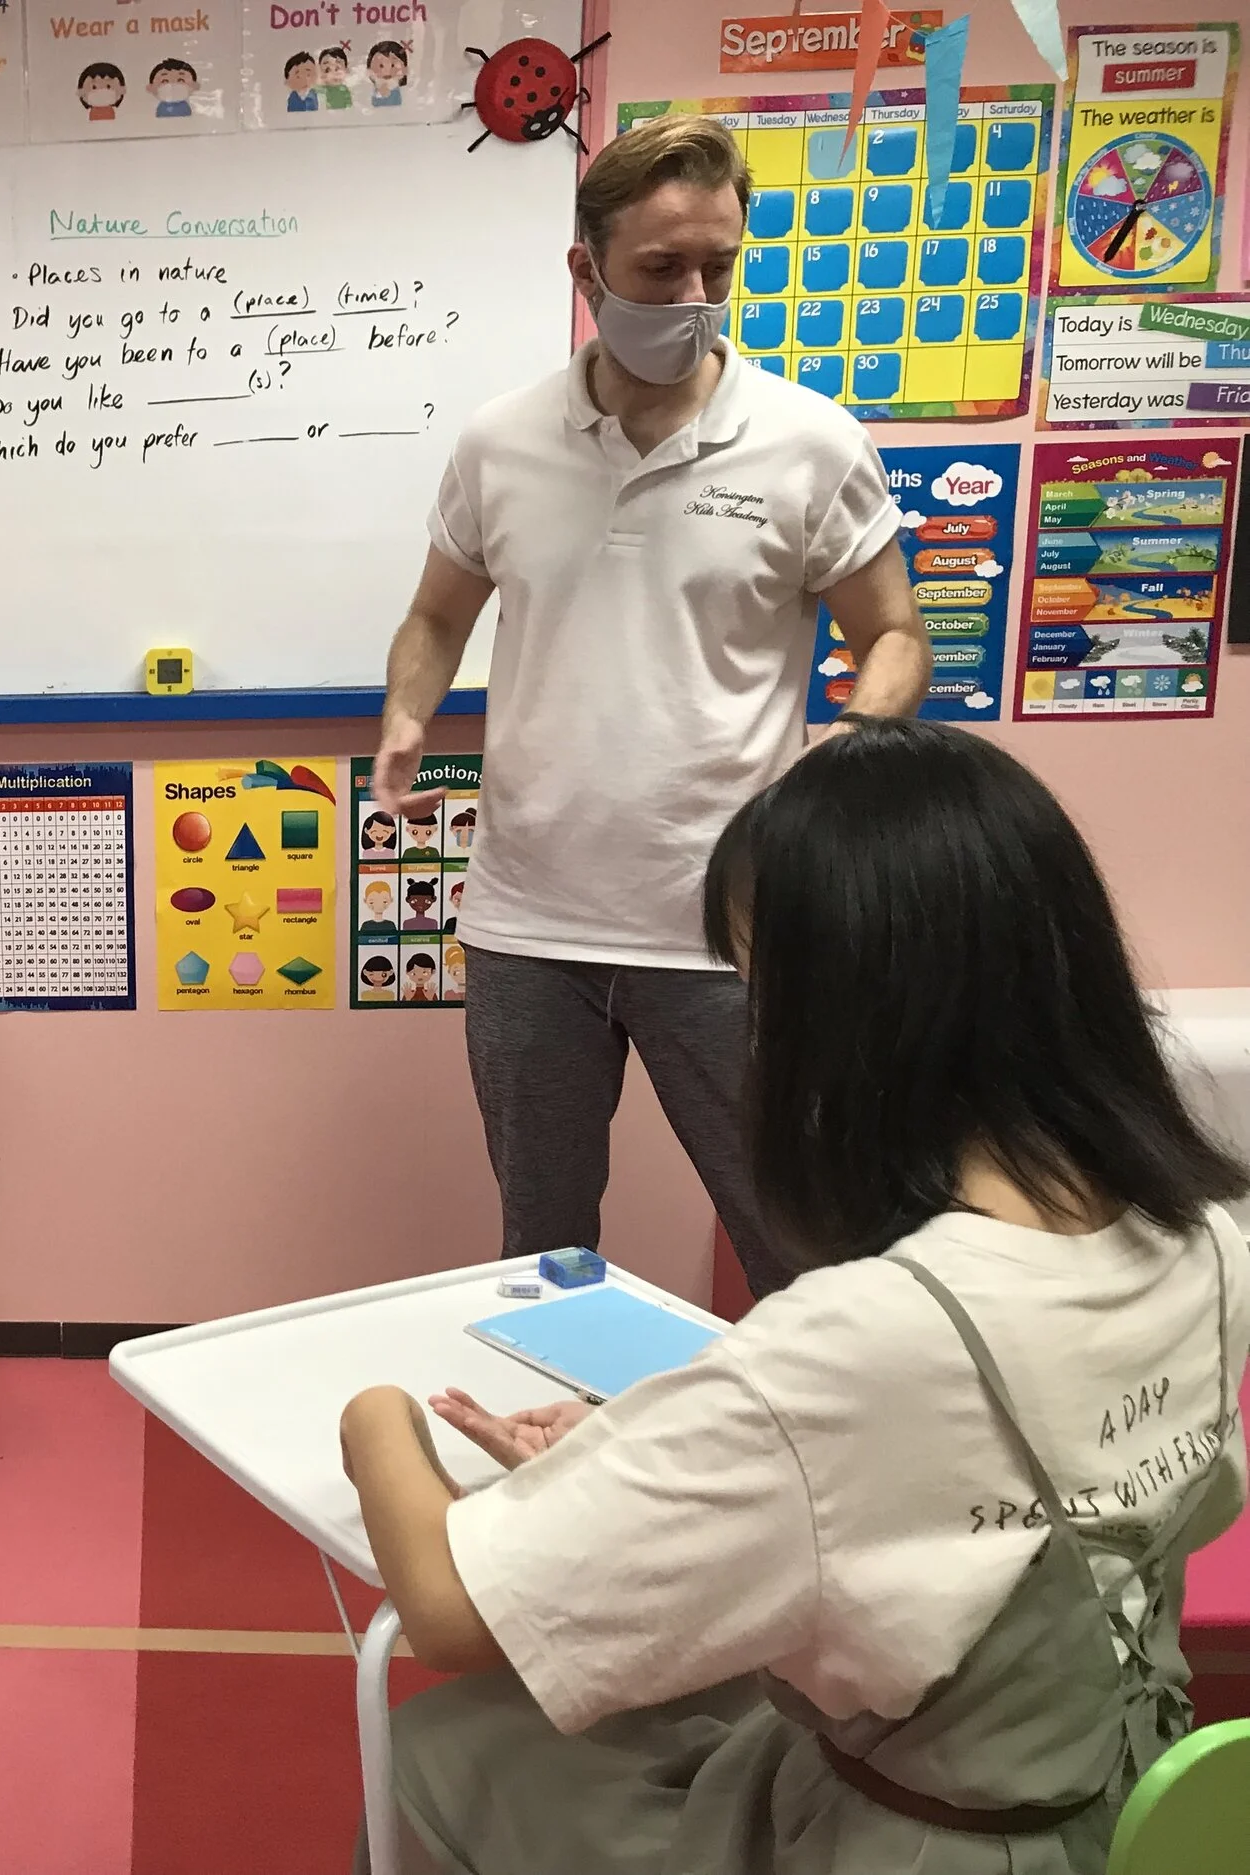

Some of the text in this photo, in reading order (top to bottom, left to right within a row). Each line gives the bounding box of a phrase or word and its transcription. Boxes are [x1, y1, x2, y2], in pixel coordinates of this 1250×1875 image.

[270, 1, 427, 29] Don't touch
[50, 10, 209, 39] Wear a mask
[1093, 38, 1217, 56] The season is
[1115, 66, 1186, 85] summer
[872, 110, 920, 120] Thursday
[990, 104, 1037, 116] Saturday
[757, 115, 796, 125] Tuesday
[1081, 107, 1215, 126] The weather is
[872, 130, 884, 144] 2
[50, 208, 298, 236] Nature Conversation
[926, 241, 939, 255] 17
[28, 257, 227, 286] Places in nature
[14, 306, 49, 330] Did
[68, 312, 104, 339] you
[120, 312, 144, 338] go
[159, 305, 181, 323] to
[200, 307, 210, 322] a
[1058, 305, 1250, 340] Today is Wednesday
[63, 352, 101, 380] you
[123, 342, 173, 365] been
[187, 336, 207, 361] to
[230, 342, 242, 358] a
[268, 325, 338, 353] (place)
[857, 356, 878, 370] 30
[1056, 352, 1202, 371] Tomorrow will be
[26, 397, 62, 426] you
[88, 384, 123, 411] like
[1054, 392, 1184, 413] Yesterday was
[55, 430, 76, 455] do
[91, 434, 127, 469] you
[142, 429, 198, 461] prefer
[307, 422, 329, 440] or
[1071, 452, 1198, 475] Seasons and Weather
[947, 476, 993, 494] Year
[700, 485, 764, 505] Kensington
[1146, 489, 1185, 500] Spring
[1045, 503, 1067, 512] April
[684, 501, 768, 528] Kids Academy
[1044, 516, 1062, 525] May
[943, 523, 970, 535] July
[1132, 536, 1182, 546] Summer
[1041, 550, 1060, 559] July
[932, 556, 977, 568] August
[1040, 562, 1071, 571] August
[1141, 583, 1164, 592] Fall
[917, 588, 986, 600] September
[1036, 608, 1078, 616] November
[925, 620, 974, 630] October
[1034, 630, 1076, 639] December
[1033, 643, 1066, 651] January
[933, 651, 977, 662] vember
[1032, 655, 1068, 664] February
[928, 683, 975, 693] cember
[412, 765, 484, 785] motion
[165, 783, 236, 803] Shapes
[182, 856, 203, 864] circle
[287, 853, 313, 861] square
[232, 864, 259, 872] triangle
[283, 916, 317, 925] rectangle
[176, 987, 210, 996] pentagon
[233, 987, 263, 996] hexagon
[284, 988, 316, 996] rhombus
[1100, 1377, 1170, 1449] A DAY
[1114, 1447, 1173, 1509] WITH
